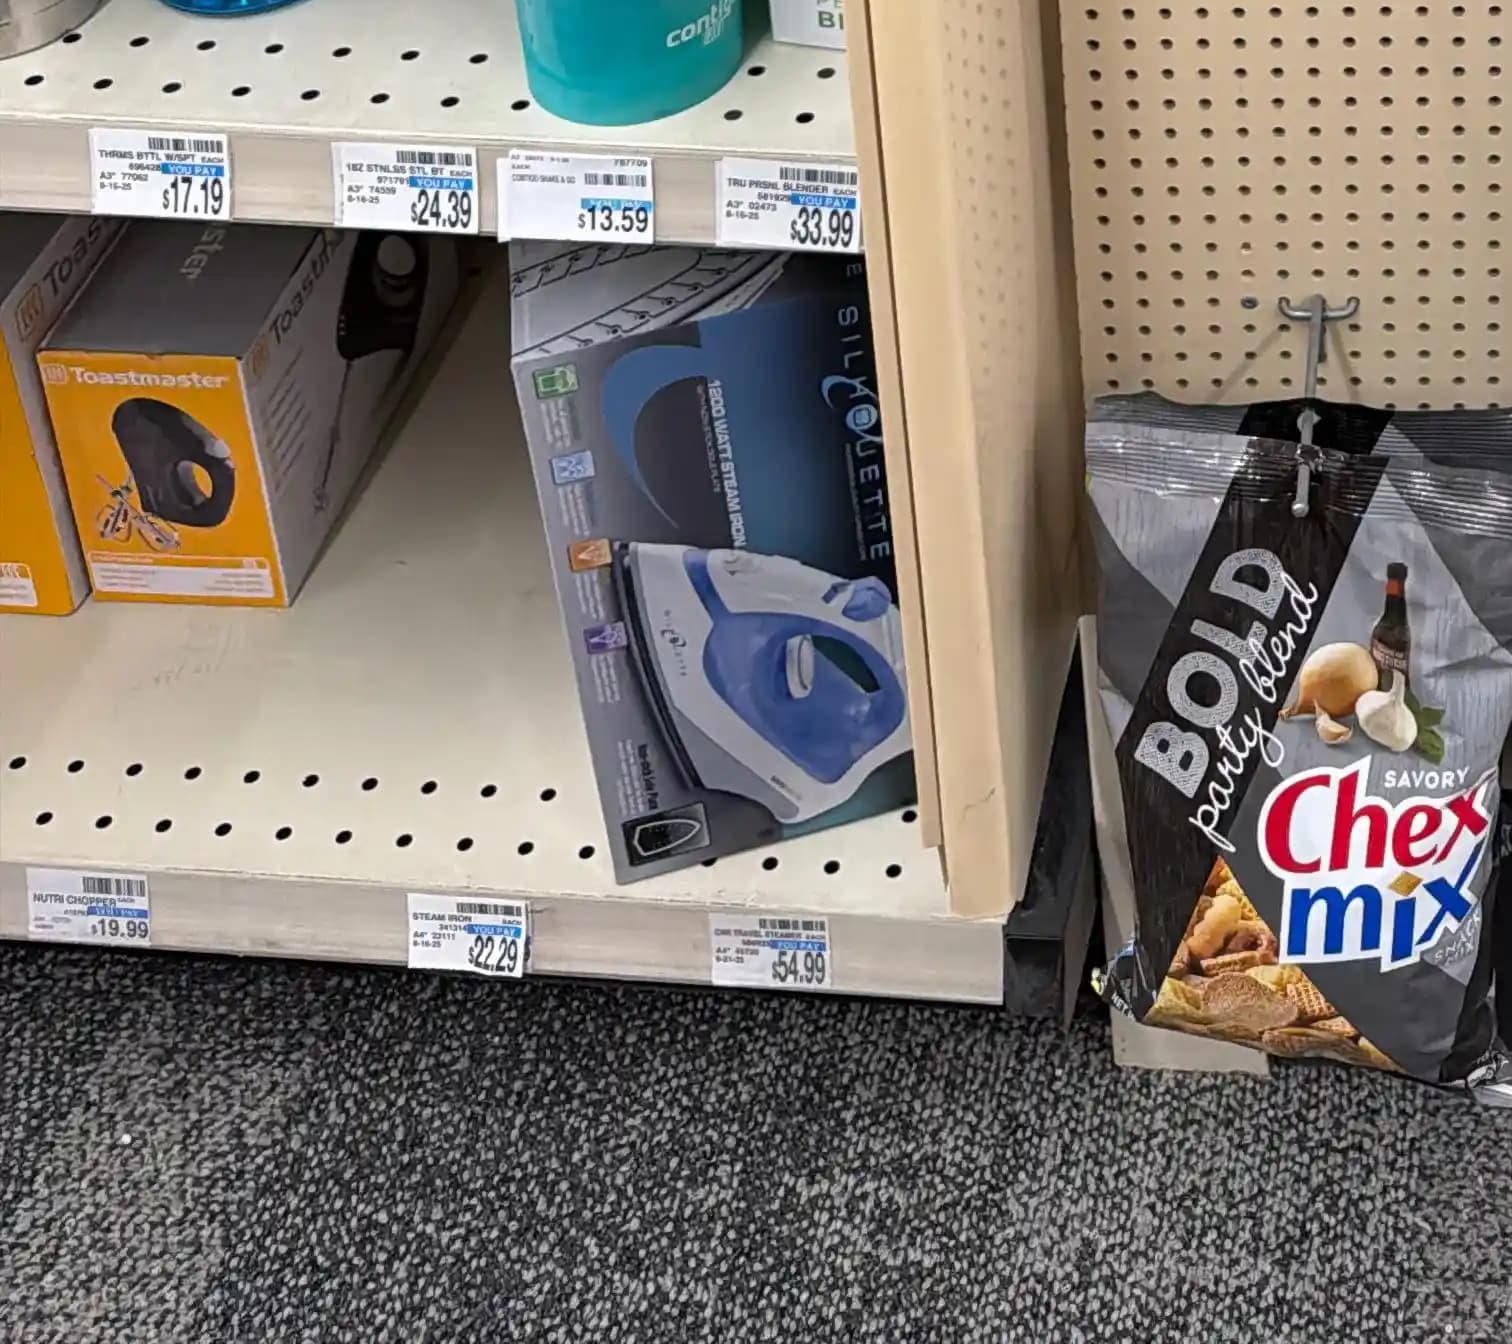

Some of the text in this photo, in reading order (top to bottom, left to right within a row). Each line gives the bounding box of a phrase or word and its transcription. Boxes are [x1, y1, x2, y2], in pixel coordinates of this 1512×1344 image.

[168, 164, 217, 176] YOU PAY
[416, 178, 466, 190] YOU PAY
[162, 175, 225, 216] $17.19
[782, 181, 829, 195] BLENDER
[798, 194, 849, 208] YOU PAY
[410, 188, 473, 229] $24.39
[577, 204, 650, 233] $13.59
[790, 206, 854, 249] $33.99
[69, 365, 232, 389] Toastmaster
[706, 379, 726, 418] 1200
[713, 417, 732, 462] WATT
[719, 461, 742, 513] STEAM
[727, 513, 749, 548] IRON
[1133, 547, 1287, 799] BOLD
[1188, 572, 1320, 854] party blend
[1383, 766, 1472, 791] SAVORY
[1264, 767, 1490, 875] Chex
[32, 893, 65, 905] NUTRI
[66, 894, 117, 907] CHOPPER
[413, 912, 446, 922] STEAM
[448, 914, 473, 923] IRON
[1286, 838, 1486, 964] mix
[91, 917, 149, 940] $19.99
[467, 934, 518, 974] $22.29
[771, 950, 826, 985] $54.99
